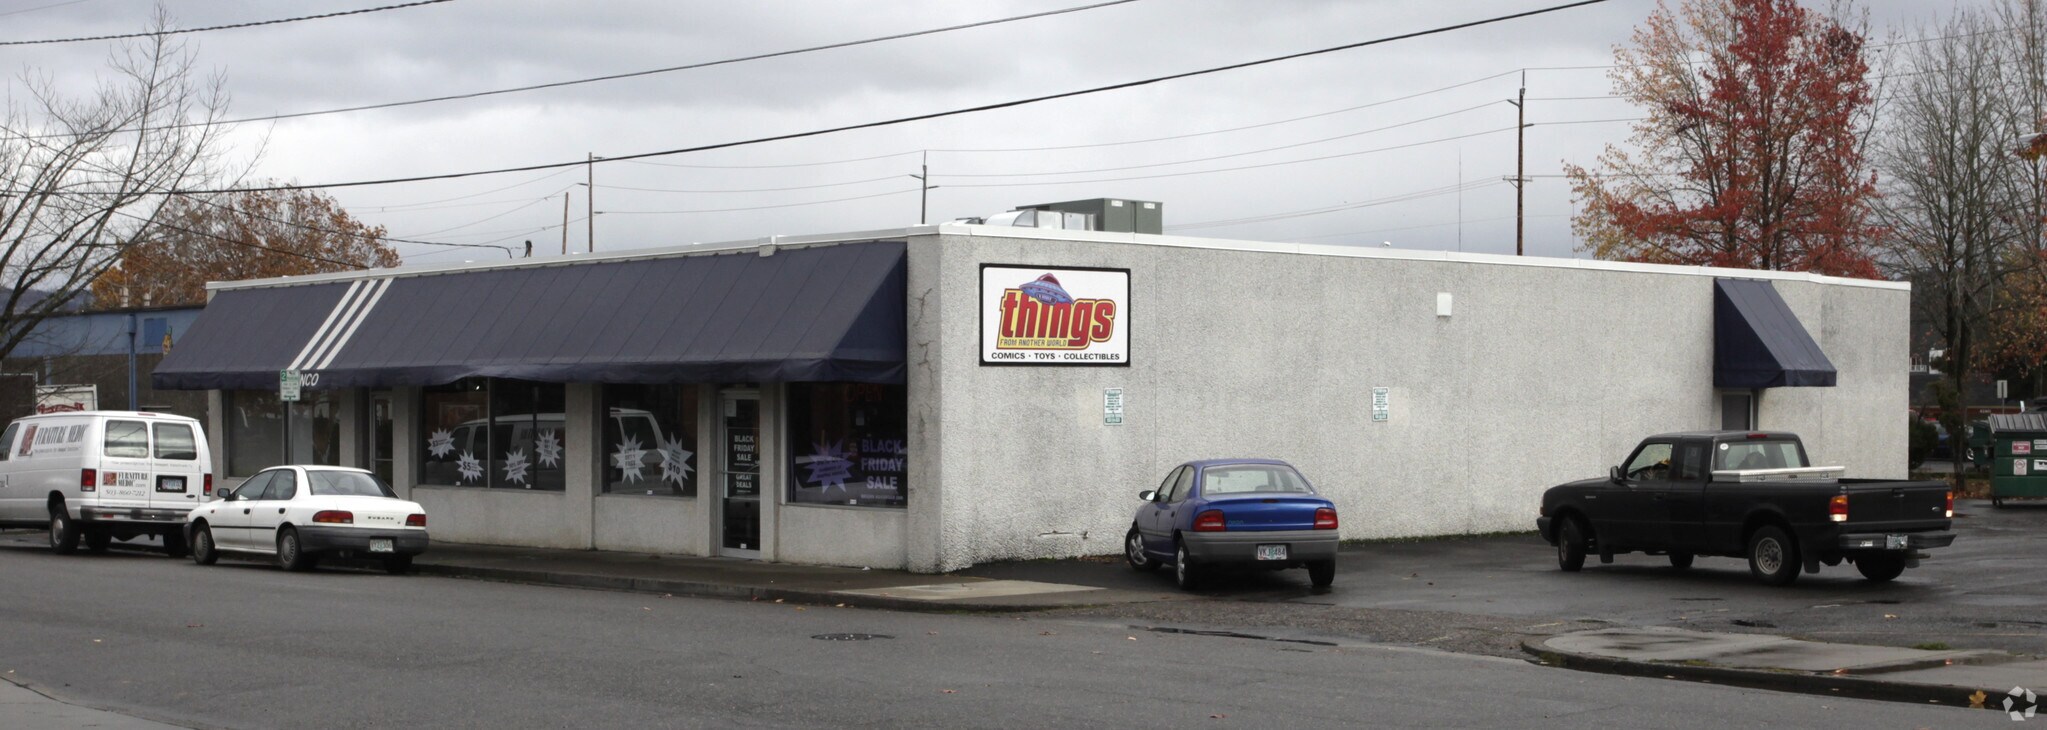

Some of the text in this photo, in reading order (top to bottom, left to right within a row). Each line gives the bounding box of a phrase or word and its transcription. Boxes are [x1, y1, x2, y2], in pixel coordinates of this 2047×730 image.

[1001, 291, 1114, 347] things
[1000, 338, 1017, 346] FROM
[1046, 339, 1067, 347] WORLD
[991, 352, 1120, 361] COMICS TOYS COLLECTIBLES
[733, 444, 755, 452] FRIDAY
[862, 439, 902, 453] BLACK
[736, 453, 752, 461] SALE
[861, 457, 904, 471] FRIDAY
[118, 472, 148, 480] FURNITURE
[866, 476, 898, 490] SALE
